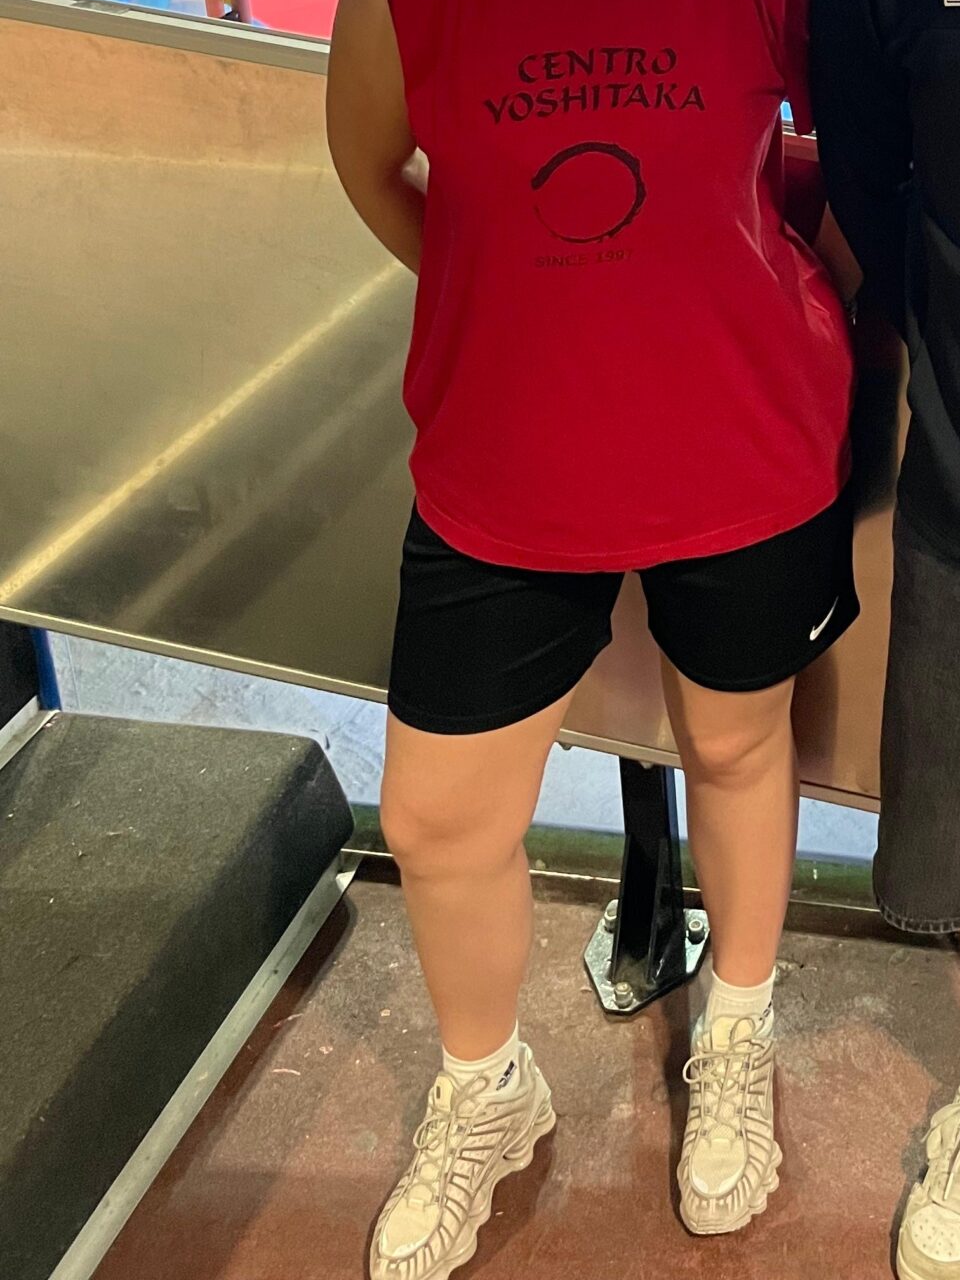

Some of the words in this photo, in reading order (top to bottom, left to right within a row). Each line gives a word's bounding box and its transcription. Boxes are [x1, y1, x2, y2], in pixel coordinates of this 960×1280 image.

[517, 47, 678, 84] CENTRO
[483, 81, 706, 125] YOSHITAKA
[534, 253, 588, 269] SINCE
